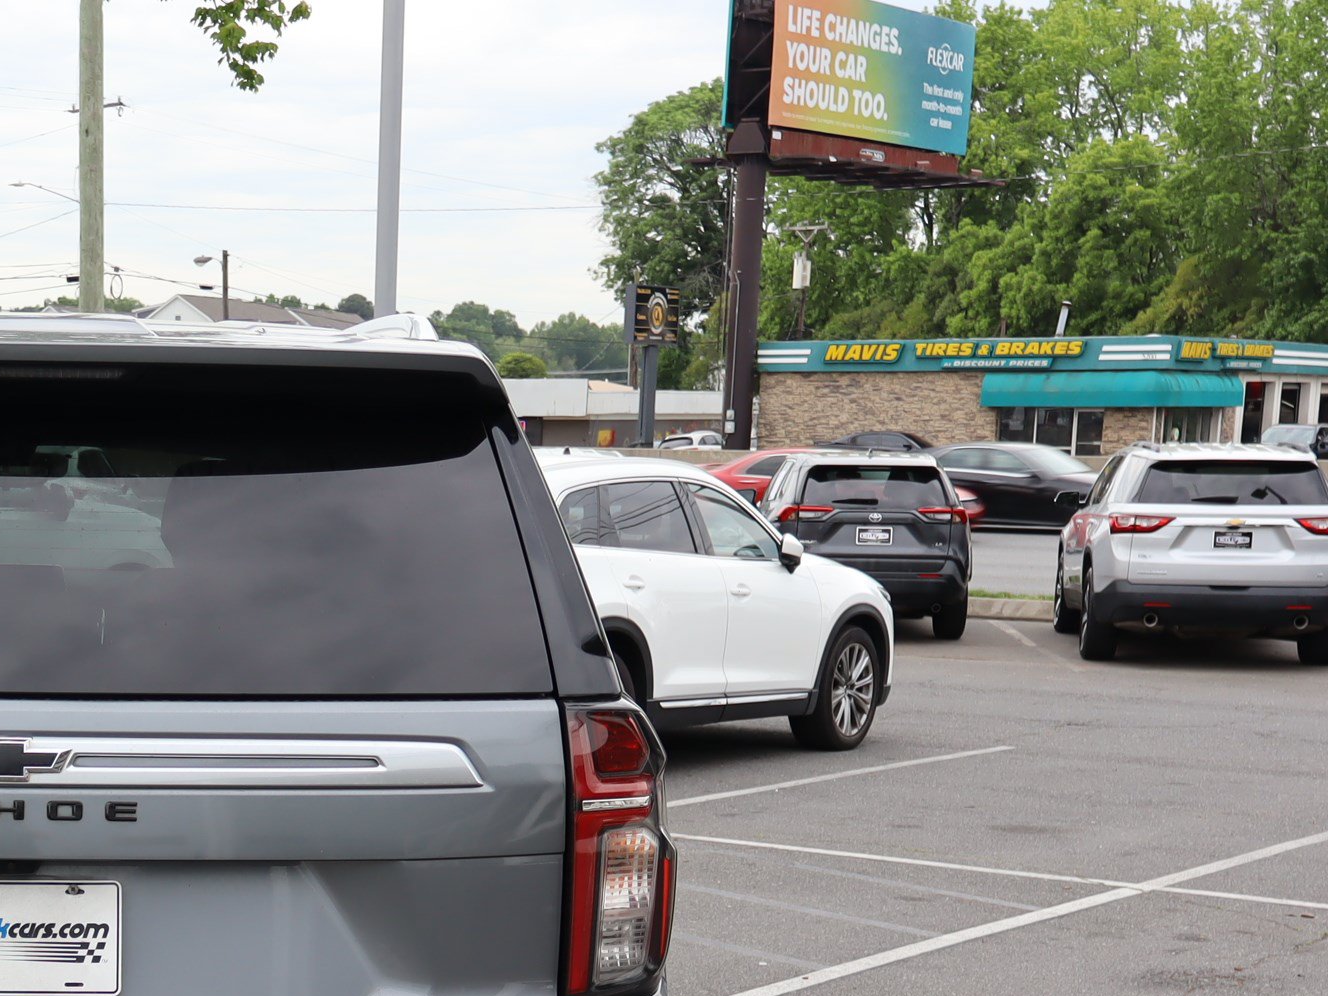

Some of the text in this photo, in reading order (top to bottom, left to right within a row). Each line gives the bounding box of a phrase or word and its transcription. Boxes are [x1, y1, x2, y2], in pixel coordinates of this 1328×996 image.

[787, 5, 903, 56] LIFE CHANGES.
[786, 40, 867, 82] YOUR CAR
[927, 47, 964, 72] FLEXCAR
[783, 76, 888, 121] SHOULD TOO.
[923, 82, 933, 95] The
[943, 88, 953, 99] and
[954, 90, 964, 103] only
[921, 100, 962, 116] month-to-month
[824, 340, 1084, 361] MAVIS TIRES & BRAKES
[1181, 341, 1212, 359] MAVIS
[1217, 342, 1238, 357] TIRES
[1244, 344, 1274, 358] BRAKES
